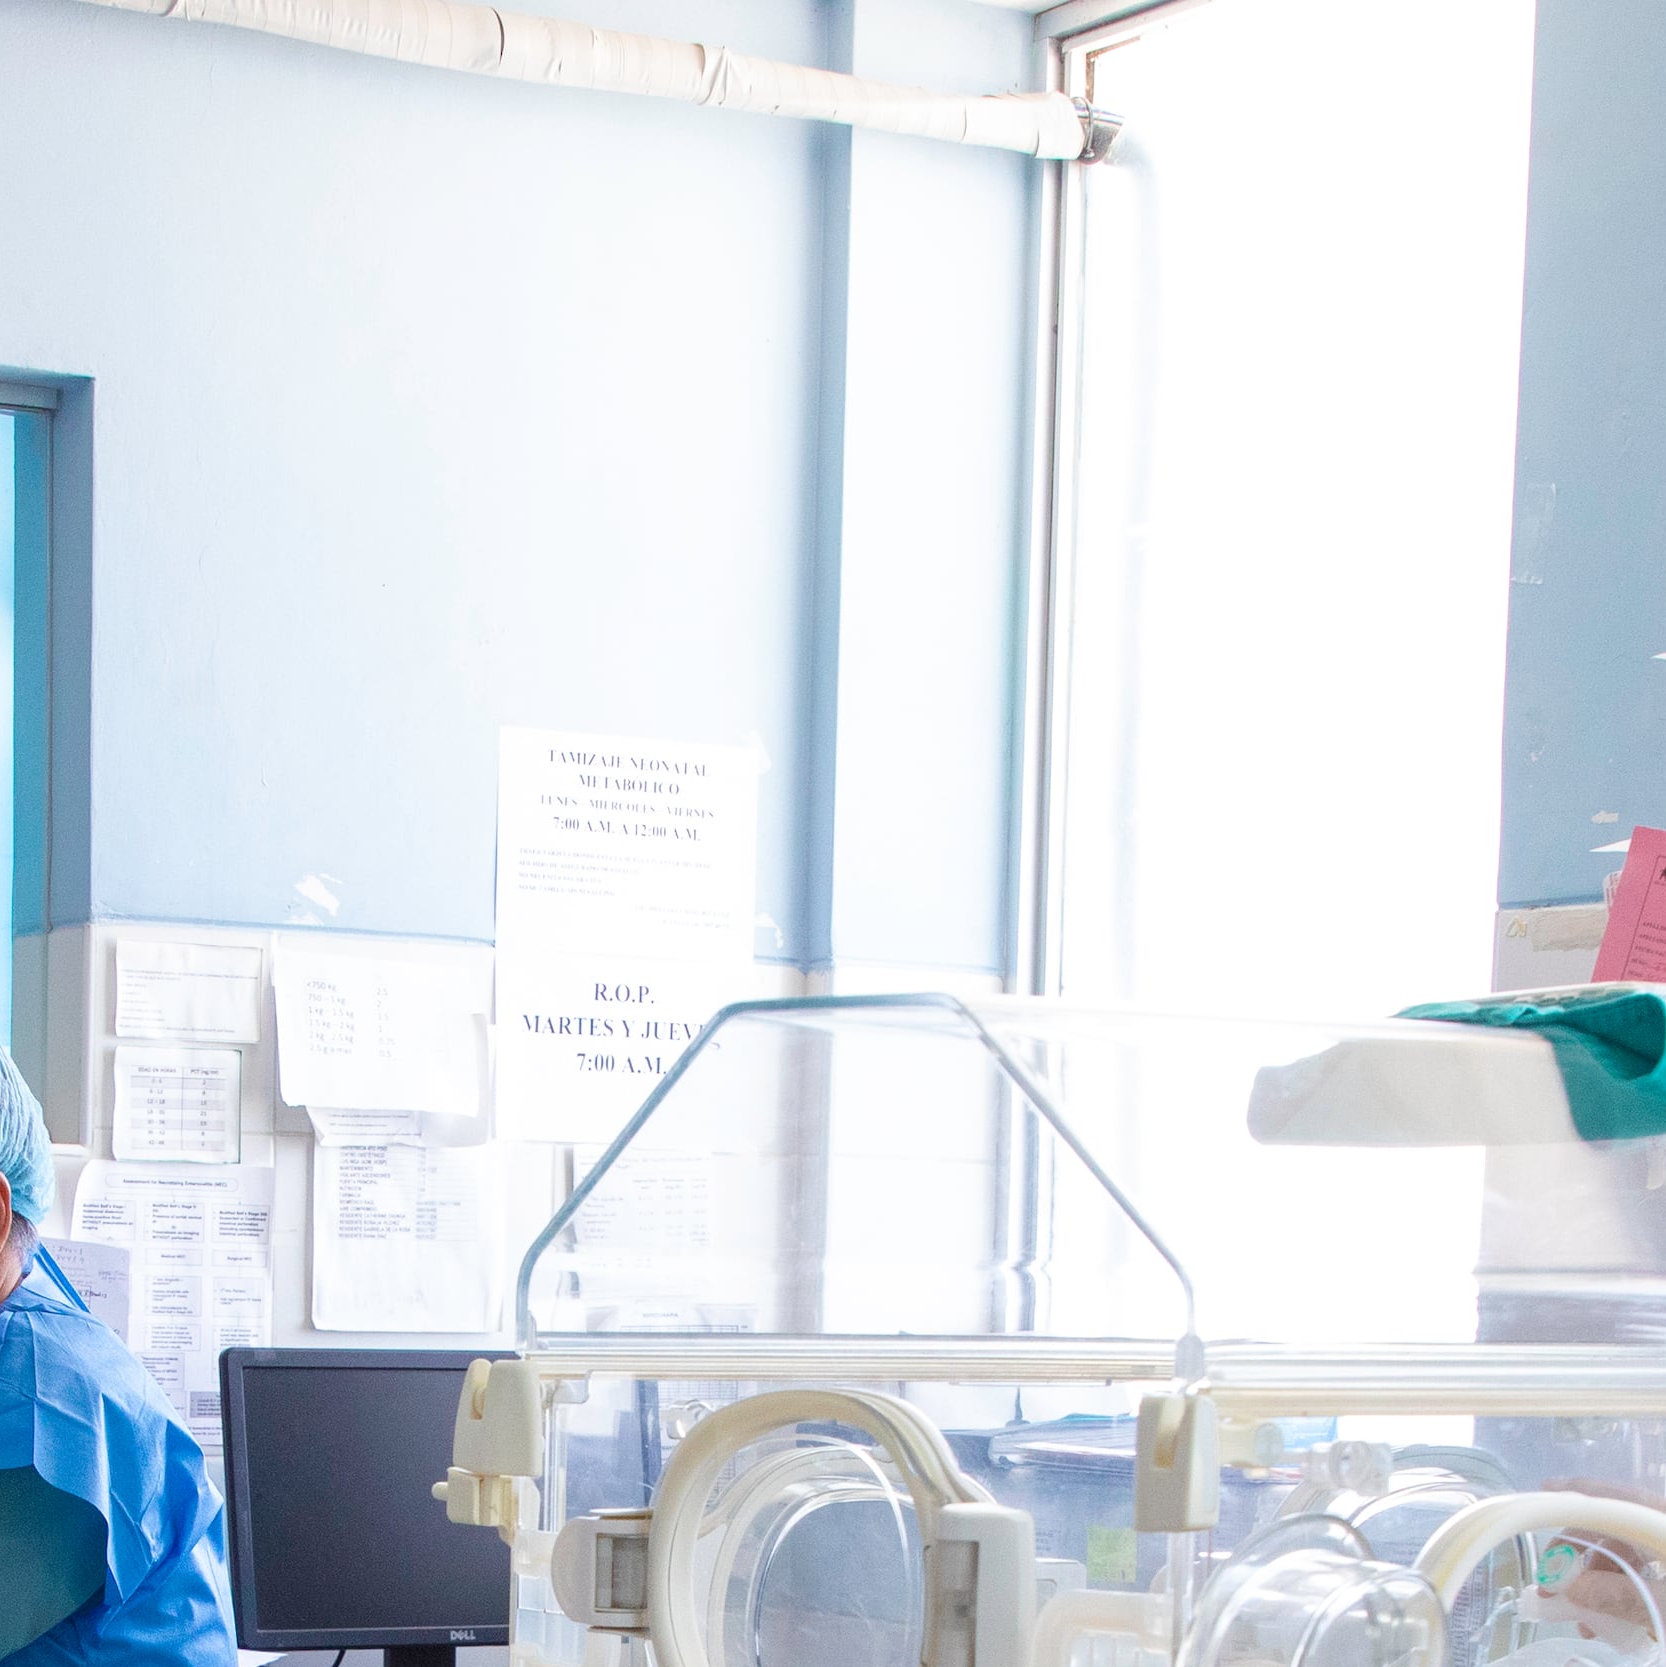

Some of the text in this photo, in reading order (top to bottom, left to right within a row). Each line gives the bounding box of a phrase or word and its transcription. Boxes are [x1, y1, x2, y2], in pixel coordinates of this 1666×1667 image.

[548, 750, 711, 777] TAMIZAJE NEONATAL
[553, 816, 701, 841] 7:00 A.M. A 12:00 A.M.
[593, 983, 654, 1004] R.O.P.
[523, 1014, 721, 1049] MARTES Y JUEVS
[576, 1053, 667, 1074] 7:00 A.M.
